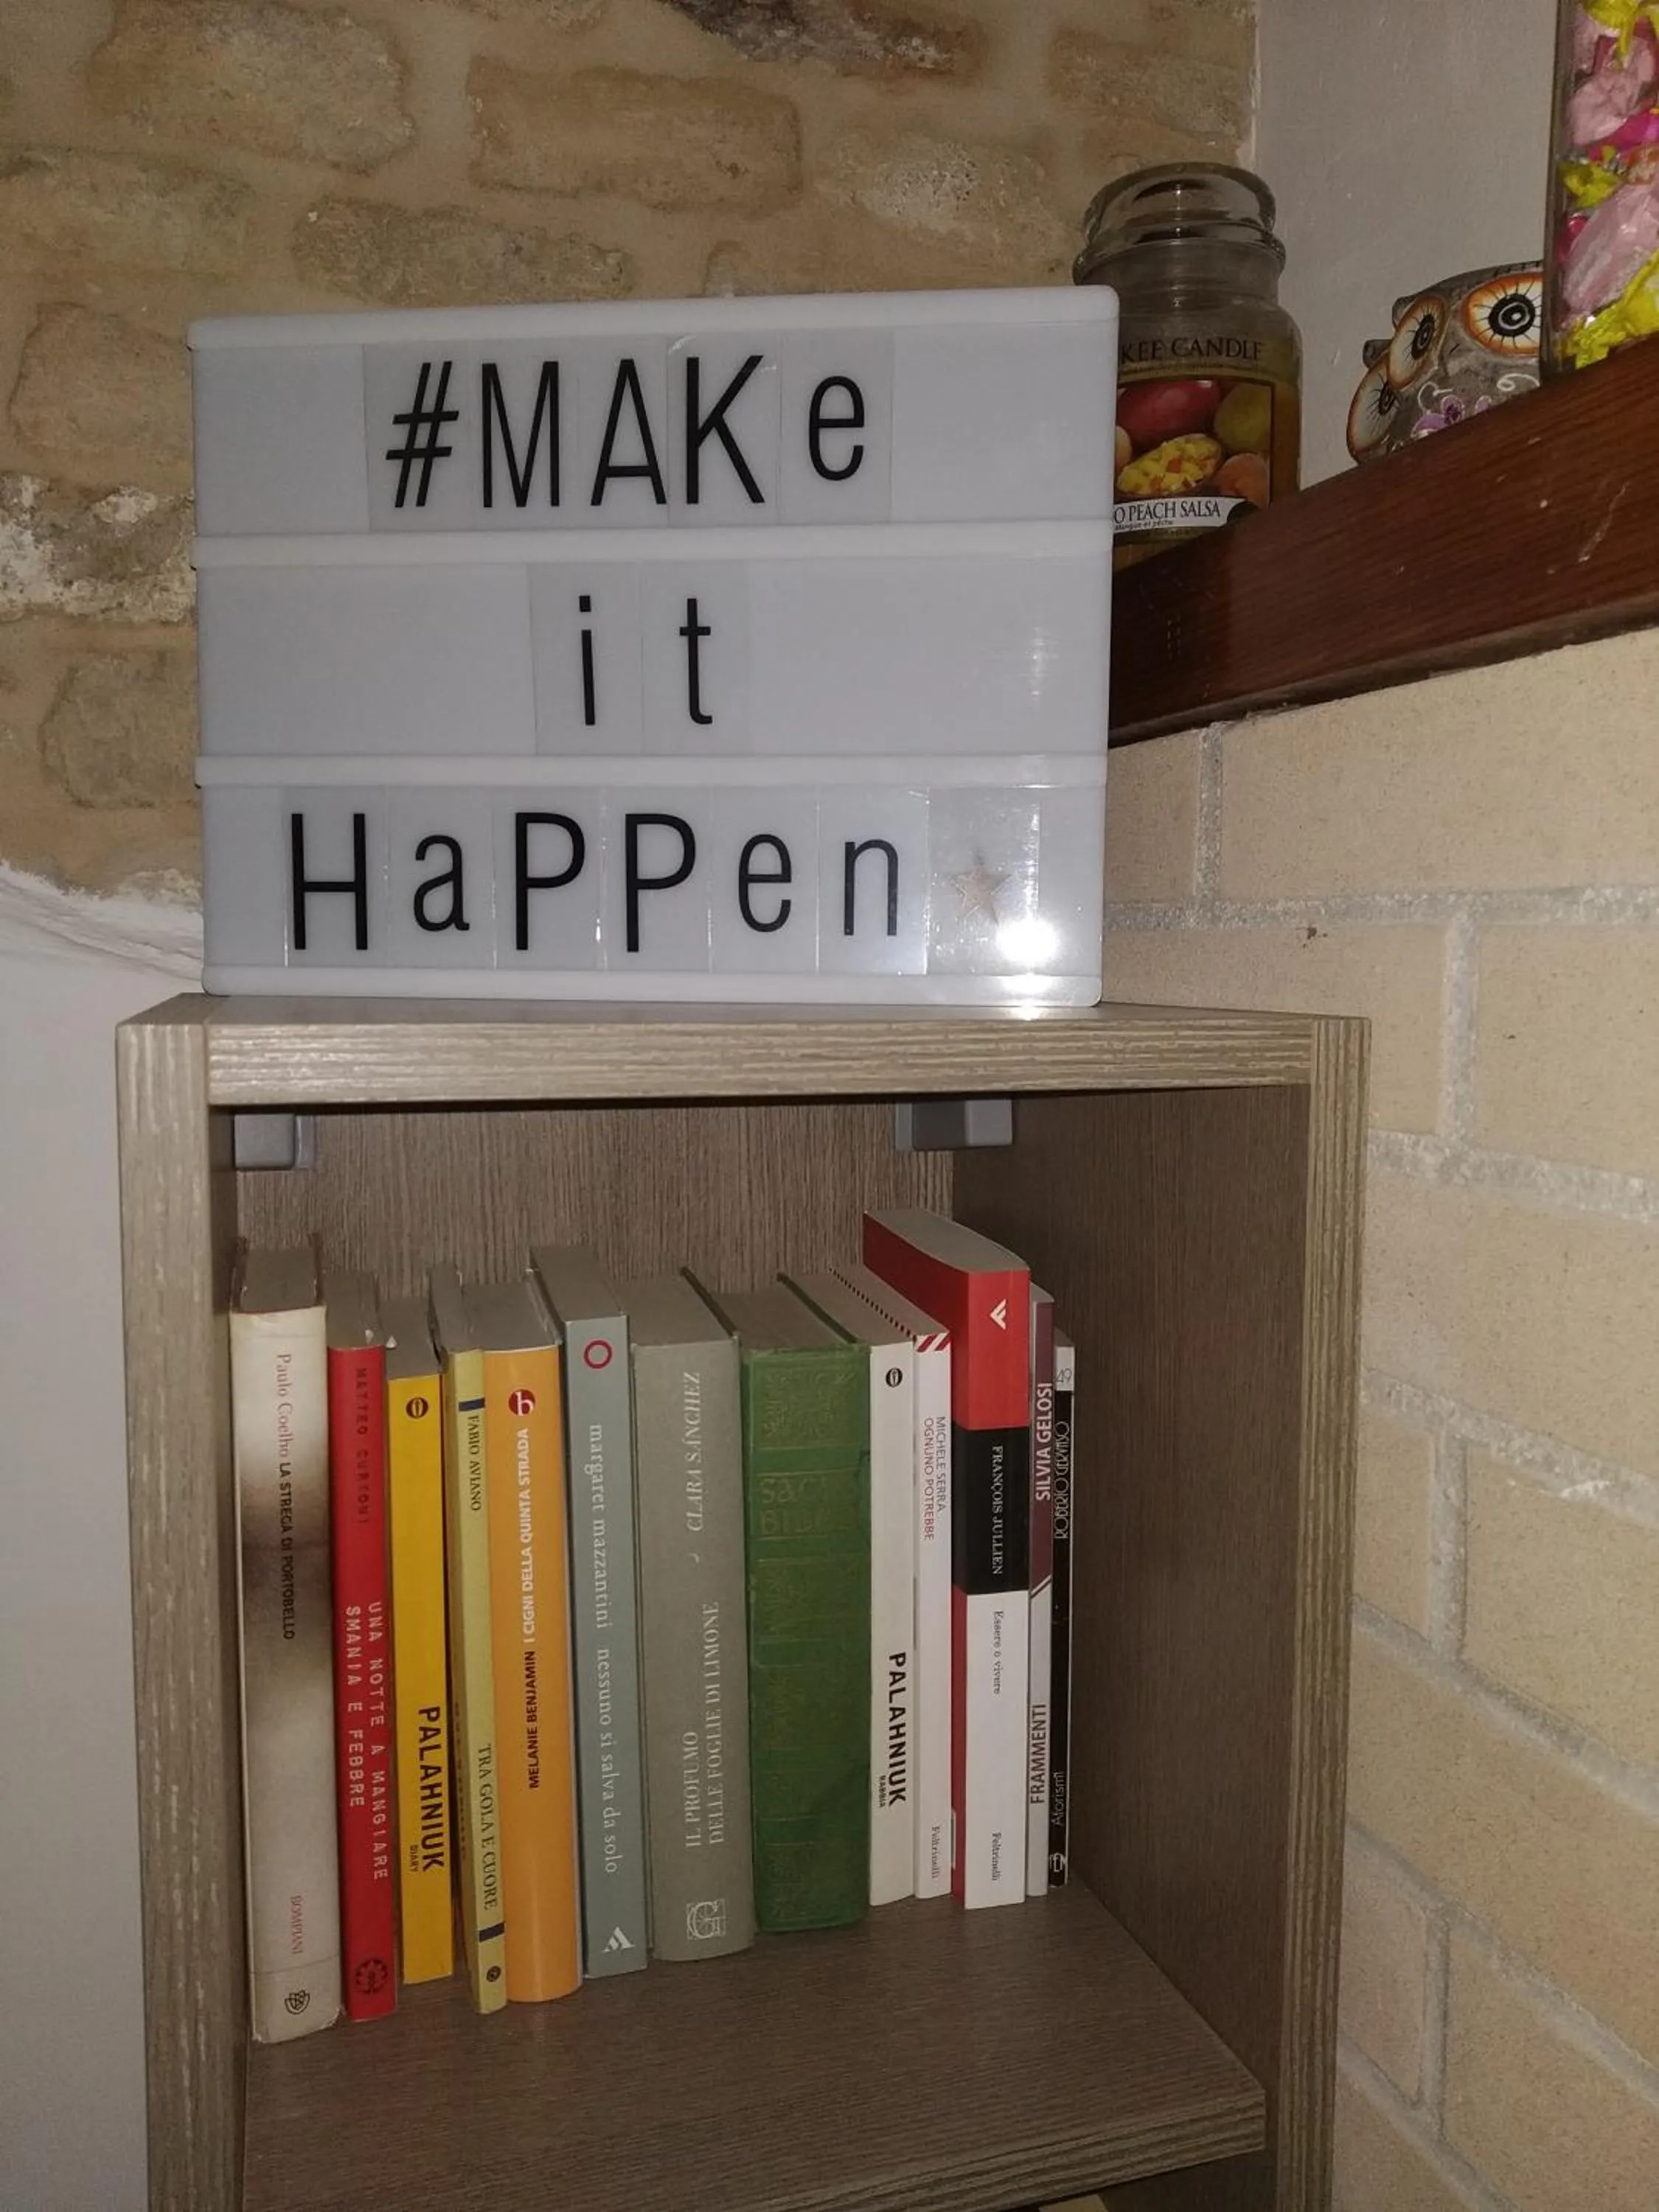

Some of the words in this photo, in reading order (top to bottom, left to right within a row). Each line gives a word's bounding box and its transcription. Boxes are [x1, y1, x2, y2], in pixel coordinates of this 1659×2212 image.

[1120, 339, 1164, 364] KEE
[1171, 336, 1262, 360] CANDLE
[1129, 501, 1177, 521] PEACH
[1180, 501, 1221, 518] SALSA
[578, 594, 713, 727] it
[276, 1353, 292, 1397] Paulo
[356, 1367, 369, 1436] MATTEO
[277, 1402, 293, 1457] Coelho
[467, 1415, 481, 1455] FABIO
[1035, 1382, 1053, 1444] GELOSI
[279, 1461, 292, 1478] LA
[516, 1427, 532, 1487] STRADA
[583, 1424, 605, 1512] margaret
[923, 1417, 934, 1475] OGNUNO
[936, 1416, 947, 1470] MICHELE
[469, 1460, 482, 1512] AVIANO
[685, 1469, 703, 1532] CLARA
[936, 1472, 947, 1512] SERRA
[990, 1445, 1004, 1514] FRANÇOIS
[1034, 1446, 1051, 1502] SILVIA
[279, 1481, 293, 1534] STREGA
[518, 1489, 534, 1544] QUINTA
[923, 1478, 935, 1541] POTREBBE
[1054, 1477, 1069, 1540] ROBERTO
[281, 1537, 294, 1550] DI
[520, 1547, 535, 1593] DELLA
[992, 1517, 1004, 1575] JULLIEN
[281, 1554, 295, 1640] PORTOBELLO
[591, 1519, 614, 1629] mazzantini
[367, 1601, 383, 1642] UNA
[521, 1595, 535, 1635] CIGNI
[702, 1601, 722, 1679] LIMONE
[992, 1610, 1005, 1649] Essere
[344, 1605, 364, 1686] SMANIA
[347, 1701, 364, 1712] E
[369, 1658, 385, 1728] NOTTE
[523, 1650, 538, 1724] BENJAMIN
[597, 1648, 613, 1725] nessuno
[703, 1683, 722, 1705] DI
[370, 1744, 384, 1756] A
[599, 1732, 618, 1748] si
[704, 1709, 724, 1780] FOGLIE
[888, 1651, 907, 1808] PALAHNIUK
[1029, 1703, 1047, 1805] FRAMMENTI
[348, 1728, 366, 1808] FEBBRE
[477, 1742, 493, 1780] TRA
[526, 1727, 540, 1790] MELANIE
[601, 1753, 621, 1800] salva
[681, 1731, 701, 1823] PROFUMO
[417, 1705, 445, 1873] PALAHNIUK
[479, 1783, 495, 1833] GOLA
[602, 1806, 622, 1829] da
[705, 1781, 725, 1845] DELLE
[1050, 1770, 1066, 1827] Aforismi
[371, 1770, 388, 1880] MANGIARE
[481, 1836, 495, 1849] E
[684, 1828, 702, 1848] IL
[482, 1851, 498, 1911] CUORE
[605, 1834, 625, 1874] solo
